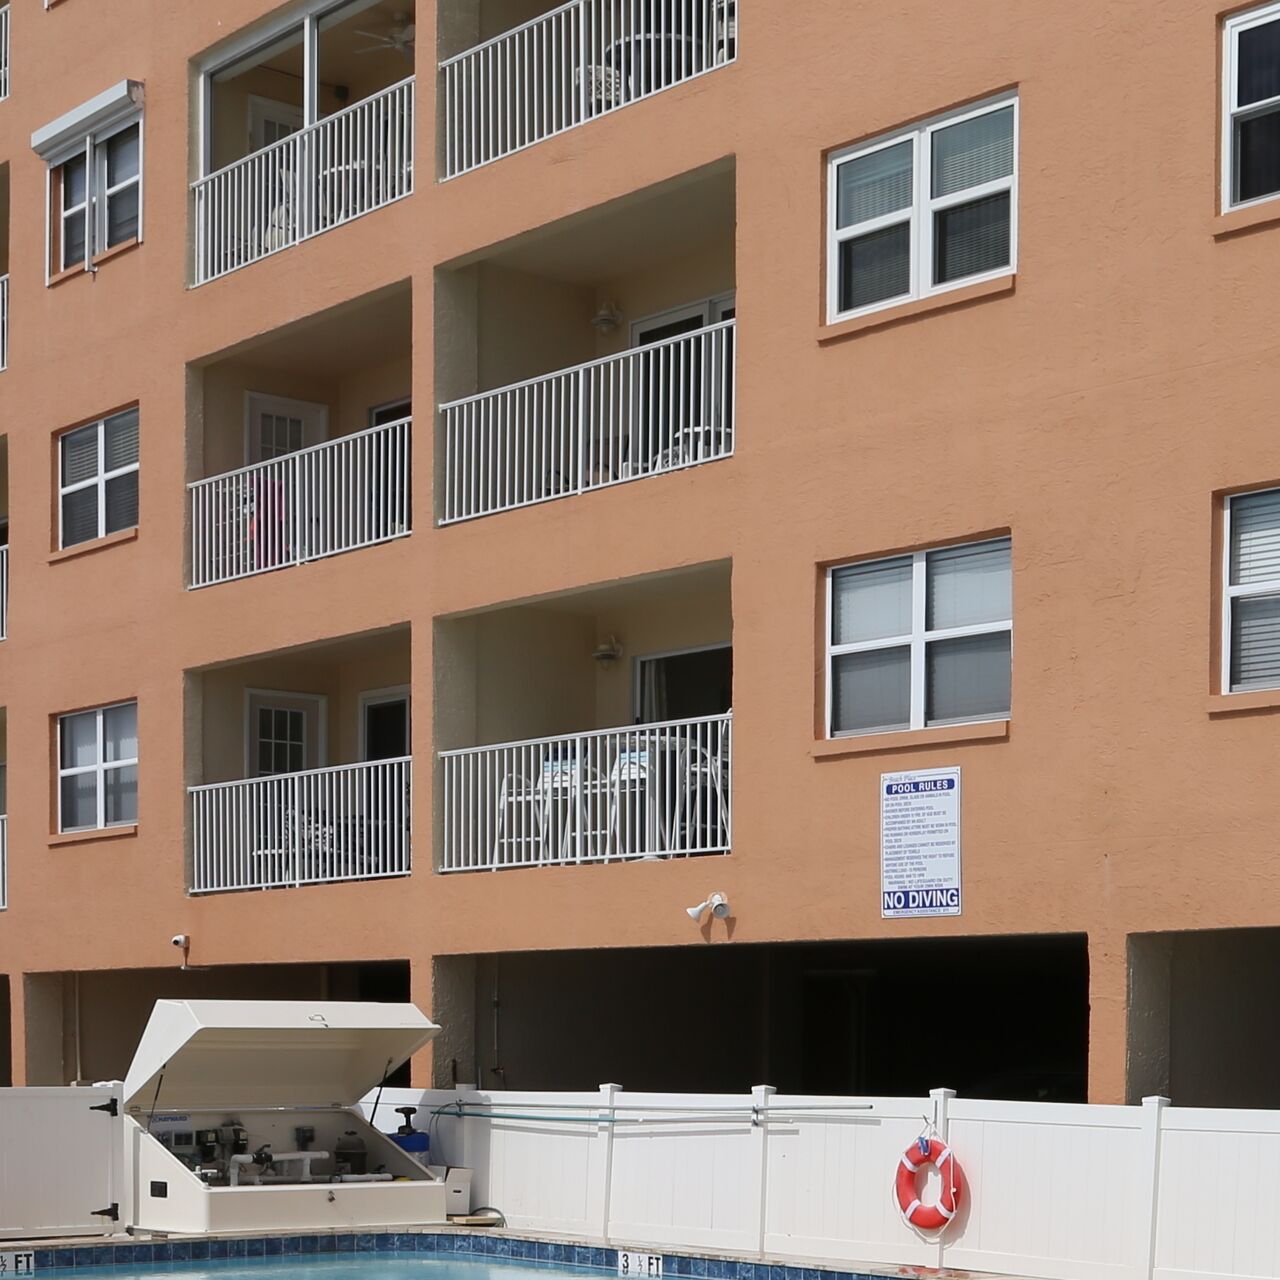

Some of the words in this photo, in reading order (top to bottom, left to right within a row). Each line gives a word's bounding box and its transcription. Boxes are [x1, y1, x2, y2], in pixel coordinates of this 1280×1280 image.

[892, 783, 916, 793] POOL
[919, 780, 948, 791] RULES
[884, 892, 905, 909] NO
[908, 889, 959, 908] DIVING
[14, 1253, 33, 1271] FT
[622, 1253, 629, 1269] 3
[648, 1256, 661, 1273] FT
